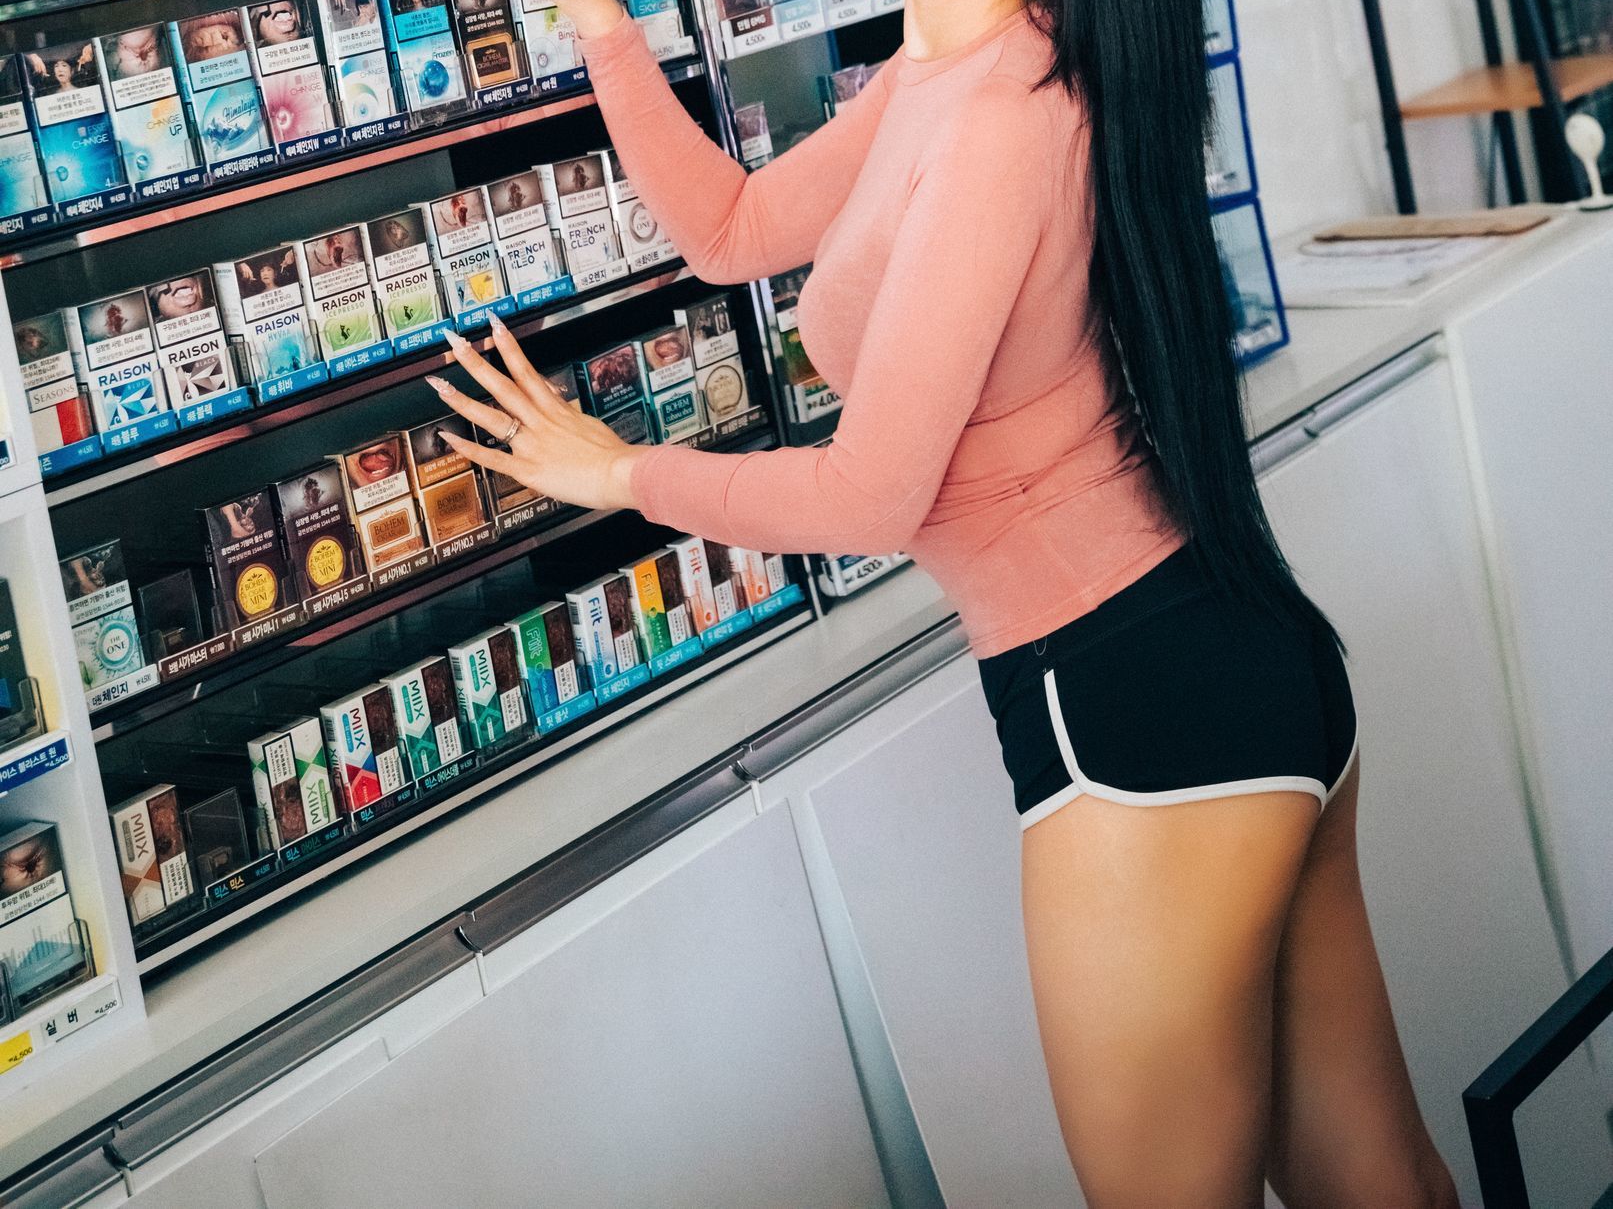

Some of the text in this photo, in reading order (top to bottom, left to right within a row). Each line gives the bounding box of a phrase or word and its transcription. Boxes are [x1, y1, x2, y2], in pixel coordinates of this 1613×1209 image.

[638, 3, 658, 15] SKY
[432, 49, 455, 60] Frozen
[147, 114, 181, 130] CHANGE
[169, 124, 183, 136] UP
[72, 134, 109, 150] CHANGE
[0, 152, 31, 166] HANGE
[450, 250, 490, 271] RAISON
[386, 272, 428, 293] RAISON
[588, 270, 607, 284] 오렌지
[322, 290, 366, 312] RAISON
[255, 313, 300, 335] RAISON
[168, 339, 219, 364] RAISON
[98, 362, 152, 387] RAISON
[33, 384, 75, 405] SEASONS
[373, 517, 405, 534] BOHEM
[106, 643, 126, 655] ONE
[476, 649, 491, 688] MIIX
[102, 681, 129, 702] 체인지
[409, 680, 426, 719] MIIX
[350, 708, 366, 750] MIIX
[306, 783, 322, 825] MIIX
[361, 808, 374, 822] 믹스
[131, 813, 149, 858] MIIX
[286, 847, 300, 861] 믹스
[215, 884, 229, 898] 믹스
[229, 875, 246, 890] 믹스
[45, 1019, 57, 1037] 실
[67, 1008, 78, 1023] 버
